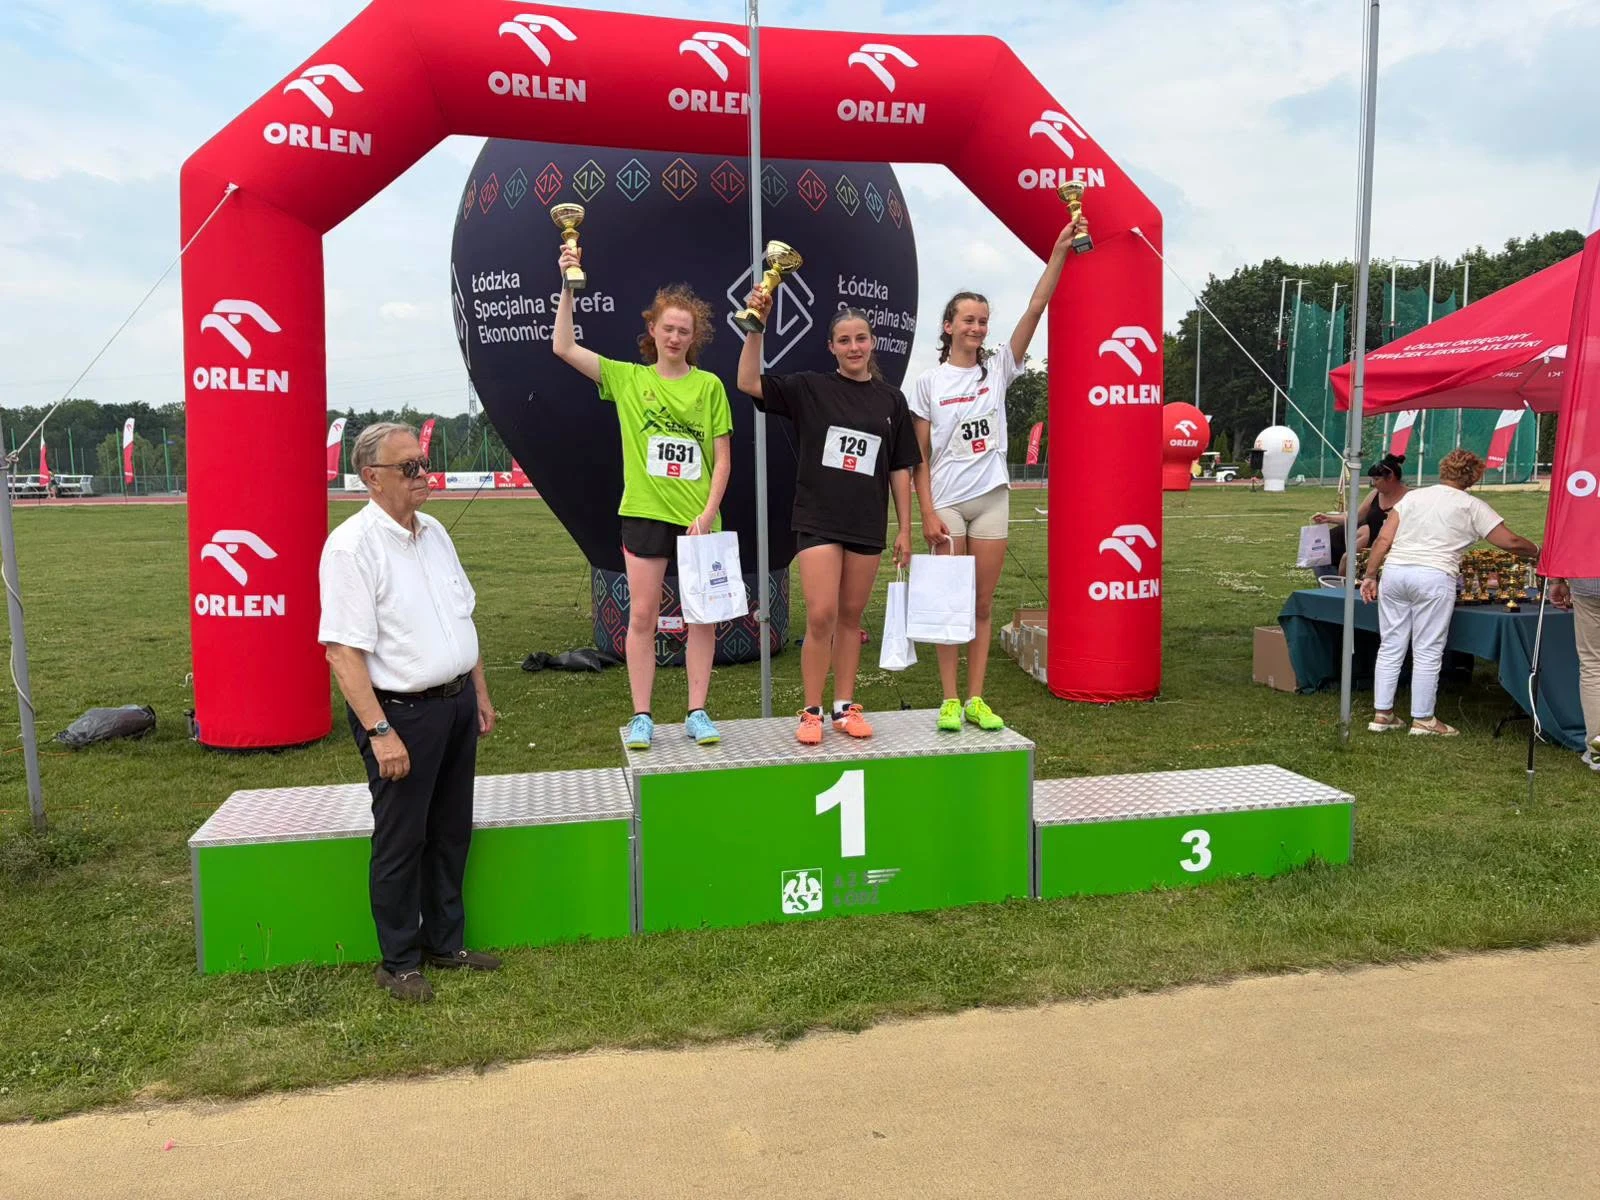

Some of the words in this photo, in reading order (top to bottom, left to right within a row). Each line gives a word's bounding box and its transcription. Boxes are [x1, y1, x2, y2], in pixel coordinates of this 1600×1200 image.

[488, 71, 587, 103] ORLEN
[837, 98, 926, 124] ORLEN
[263, 122, 372, 156] ORLEN
[1018, 167, 1105, 190] ORLEN
[472, 270, 521, 293] Łódzka
[838, 274, 889, 300] Łódzka
[474, 294, 546, 322] Specjalna
[550, 292, 615, 314] Srefa
[838, 302, 900, 329] Scjalna
[478, 320, 584, 344] Ekonomicza
[876, 332, 908, 355] miczna
[193, 366, 289, 393] ORLEN
[1088, 384, 1161, 406] ORLEN
[961, 418, 990, 441] 378
[656, 442, 694, 464] 1631
[839, 435, 868, 457] 129
[1169, 438, 1199, 447] ORLEN
[1088, 578, 1160, 601] ORLEN
[194, 593, 286, 617] ORLEN
[815, 769, 866, 858] 1
[1179, 829, 1212, 872] 3
